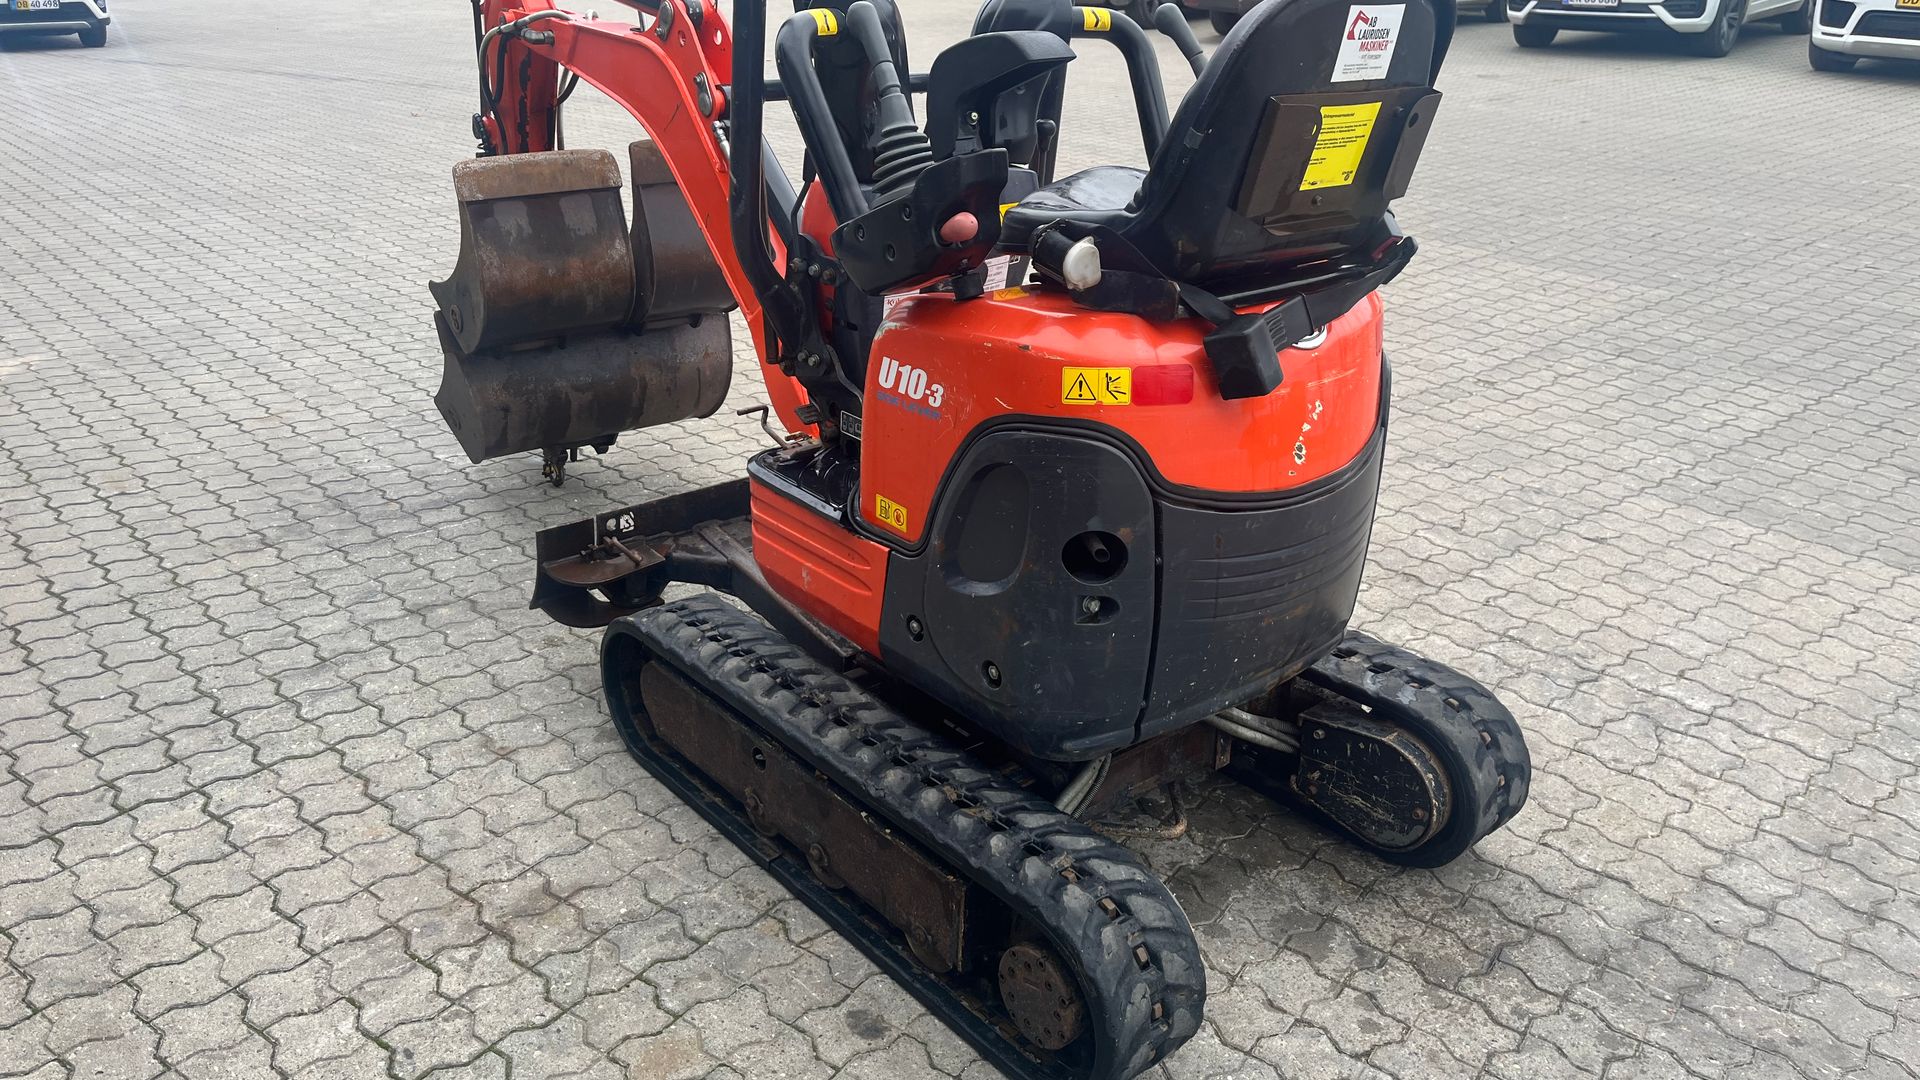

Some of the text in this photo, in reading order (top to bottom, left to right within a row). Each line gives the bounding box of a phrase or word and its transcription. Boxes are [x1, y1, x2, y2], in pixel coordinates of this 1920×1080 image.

[30, 0, 41, 8] 40
[1368, 16, 1378, 27] AB
[1359, 40, 1389, 52] MASKINER
[878, 356, 944, 408] U10-3
